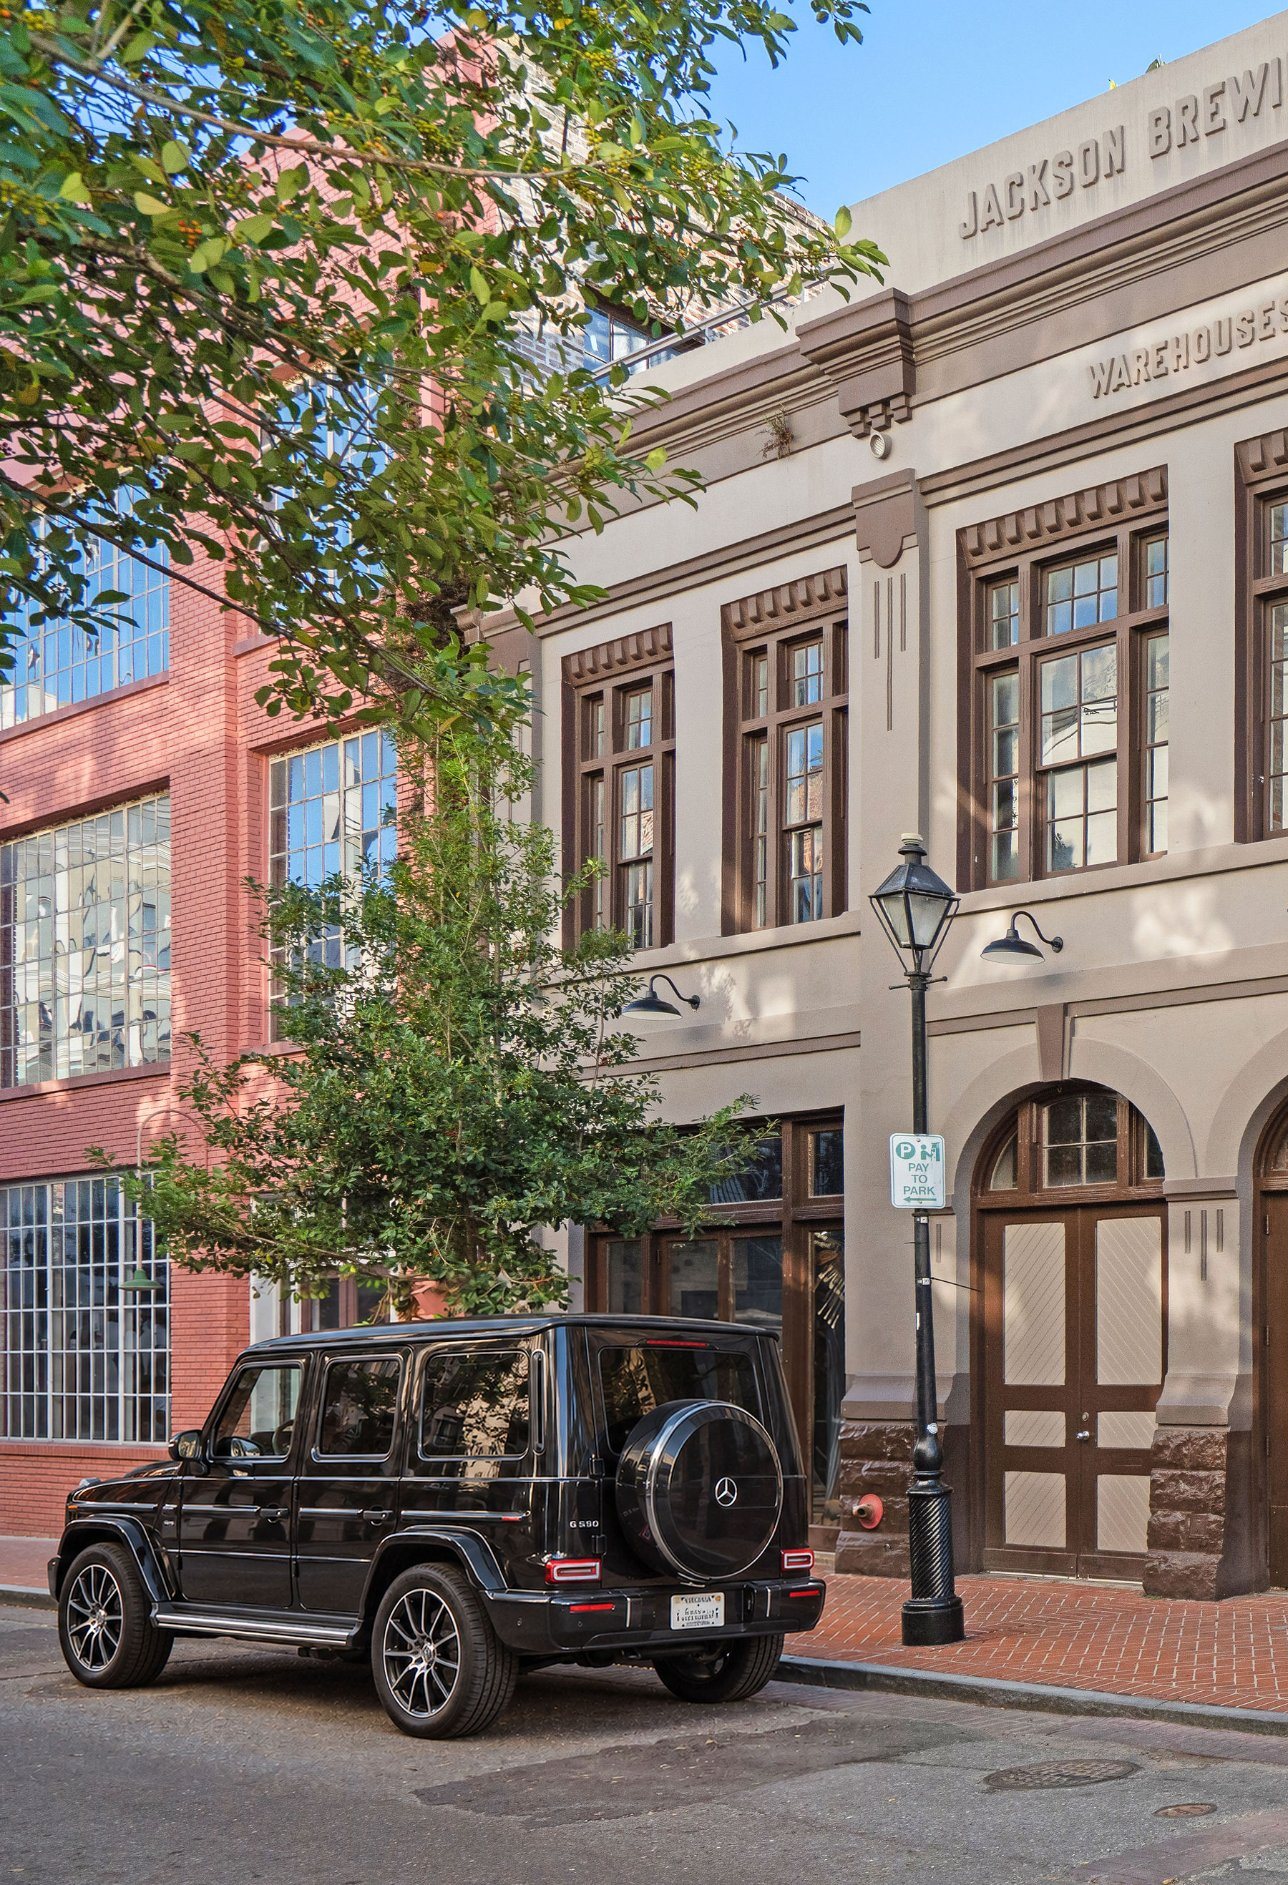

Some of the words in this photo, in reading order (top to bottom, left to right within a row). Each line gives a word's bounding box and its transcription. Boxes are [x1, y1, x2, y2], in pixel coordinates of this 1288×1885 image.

[959, 124, 1126, 240] JACKSON
[908, 1162, 930, 1172] PAY
[911, 1174, 928, 1184] TO
[903, 1185, 936, 1196] PARK
